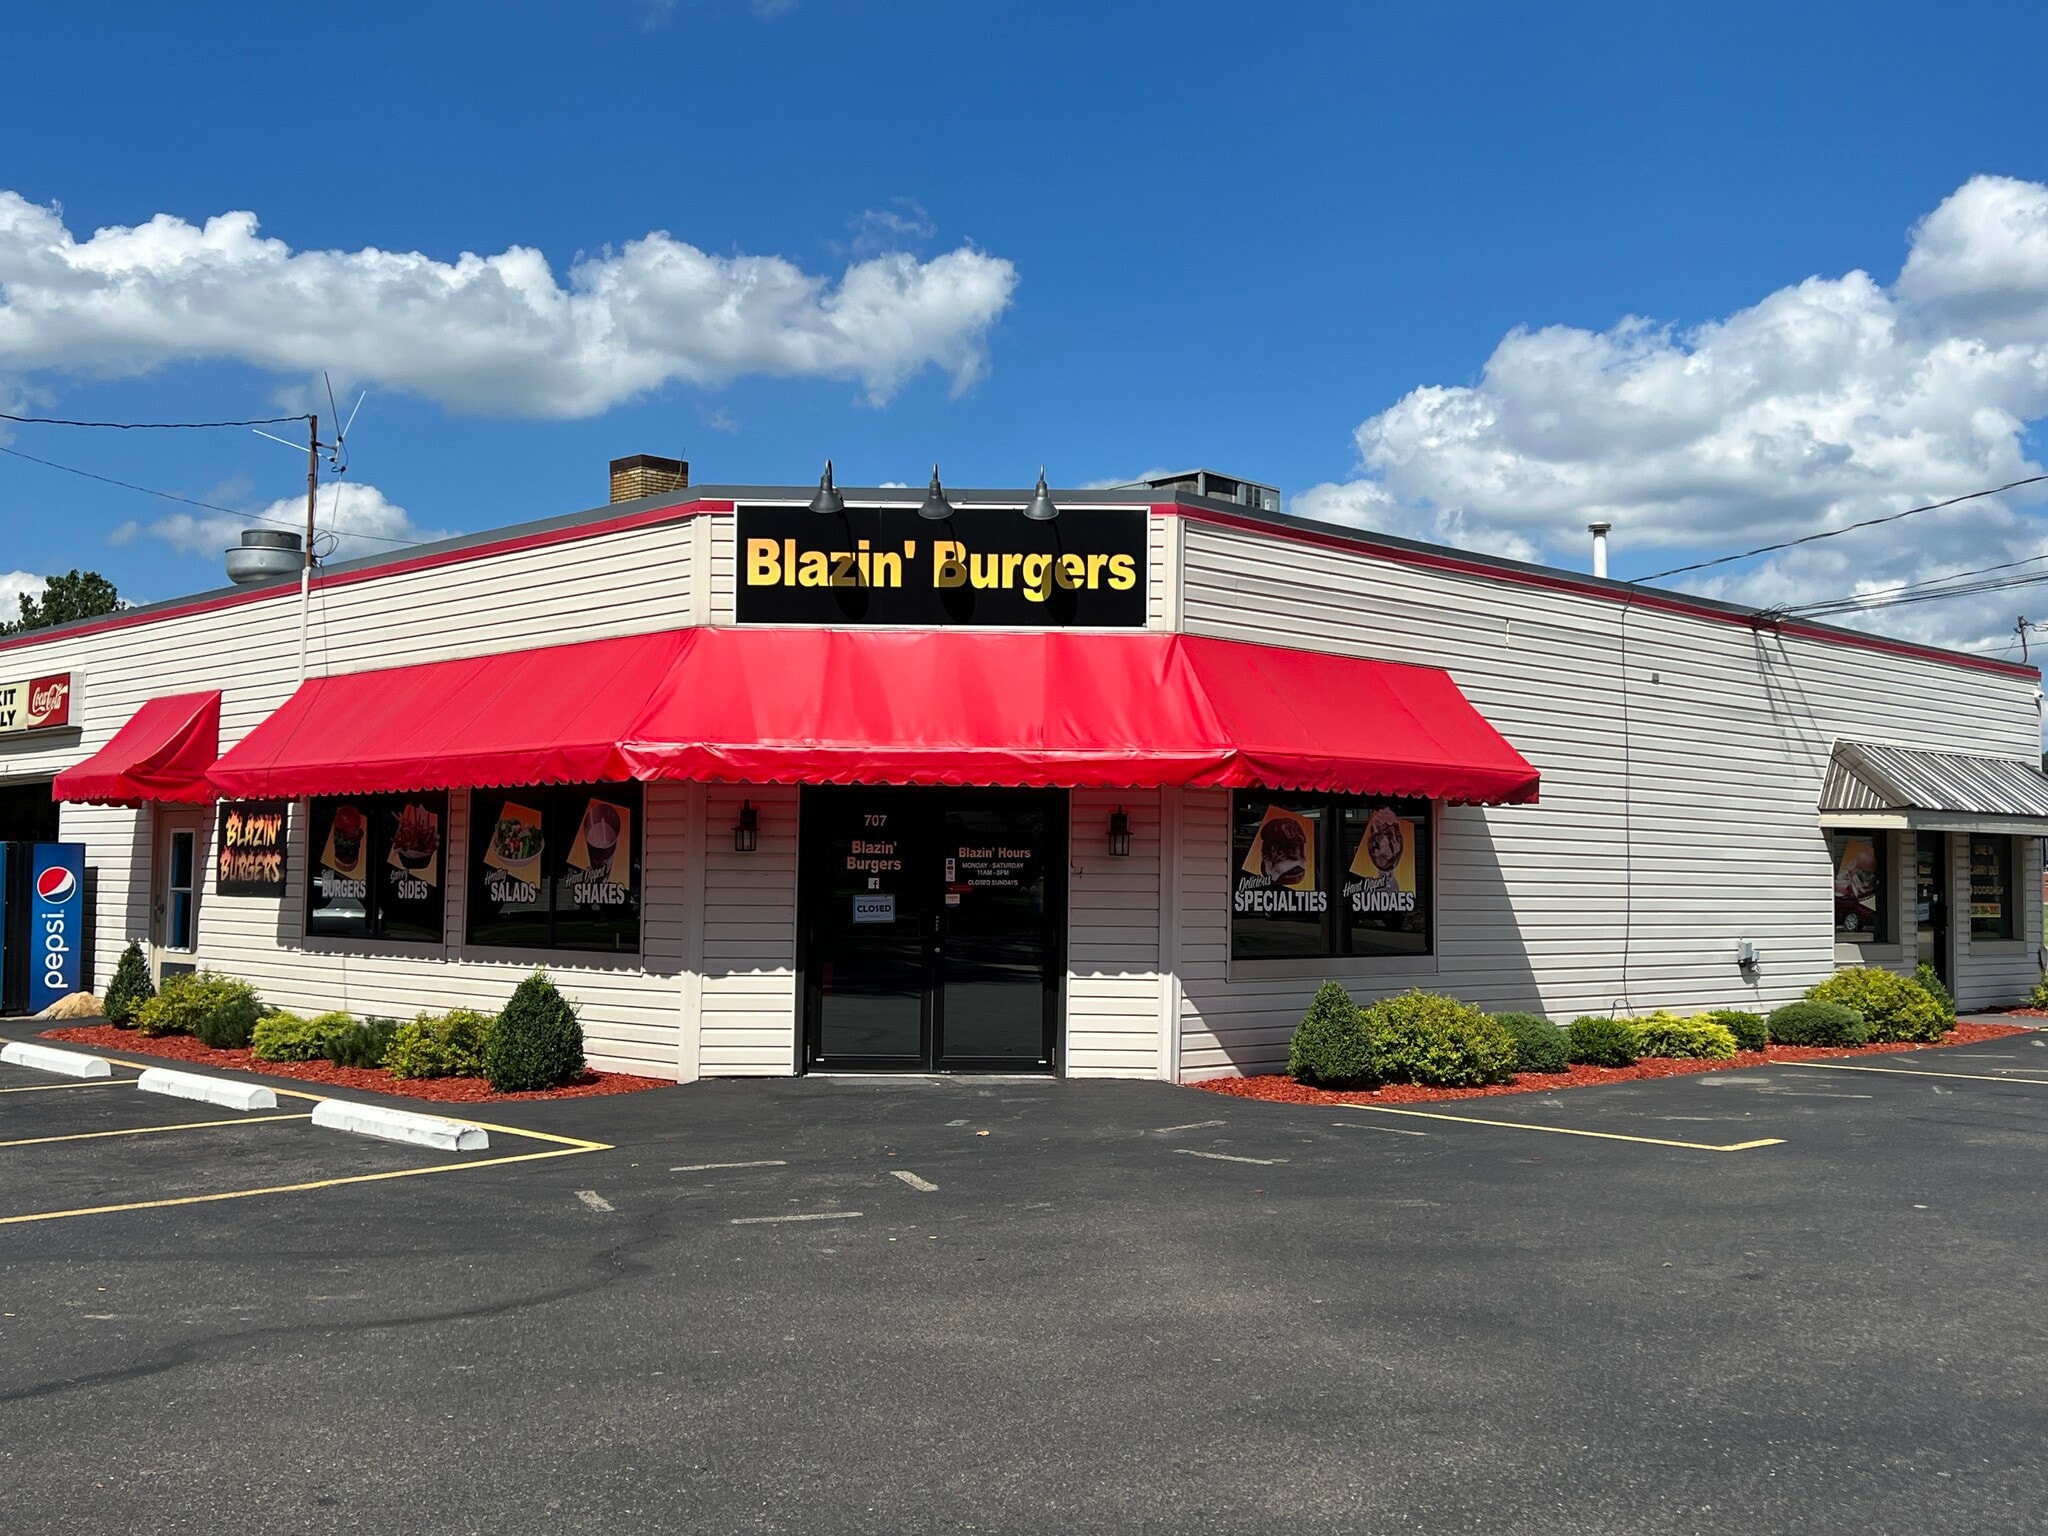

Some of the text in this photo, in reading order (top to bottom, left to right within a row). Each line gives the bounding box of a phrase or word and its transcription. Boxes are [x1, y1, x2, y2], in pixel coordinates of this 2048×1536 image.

[747, 538, 1137, 603] Blazin' Burgers
[225, 810, 282, 847] BLAZIN'
[863, 814, 888, 827] 707
[851, 840, 898, 855] Blazin'
[958, 847, 1032, 859] Blazin' Hours
[219, 846, 282, 883] BURGERS
[846, 856, 902, 874] Burgers
[322, 879, 367, 898] BURGERS
[398, 881, 428, 900] SIDES
[490, 881, 536, 902] SALADS
[991, 879, 1019, 887] SUNDAYS
[1238, 875, 1273, 893] Delicious
[1342, 880, 1364, 898] Hand
[574, 882, 625, 904] SHAKES
[1234, 890, 1328, 912] SPECIALTIES
[1352, 891, 1415, 912] SUNDAES
[857, 905, 892, 913] CLOSED
[42, 913, 69, 988] pepsi
